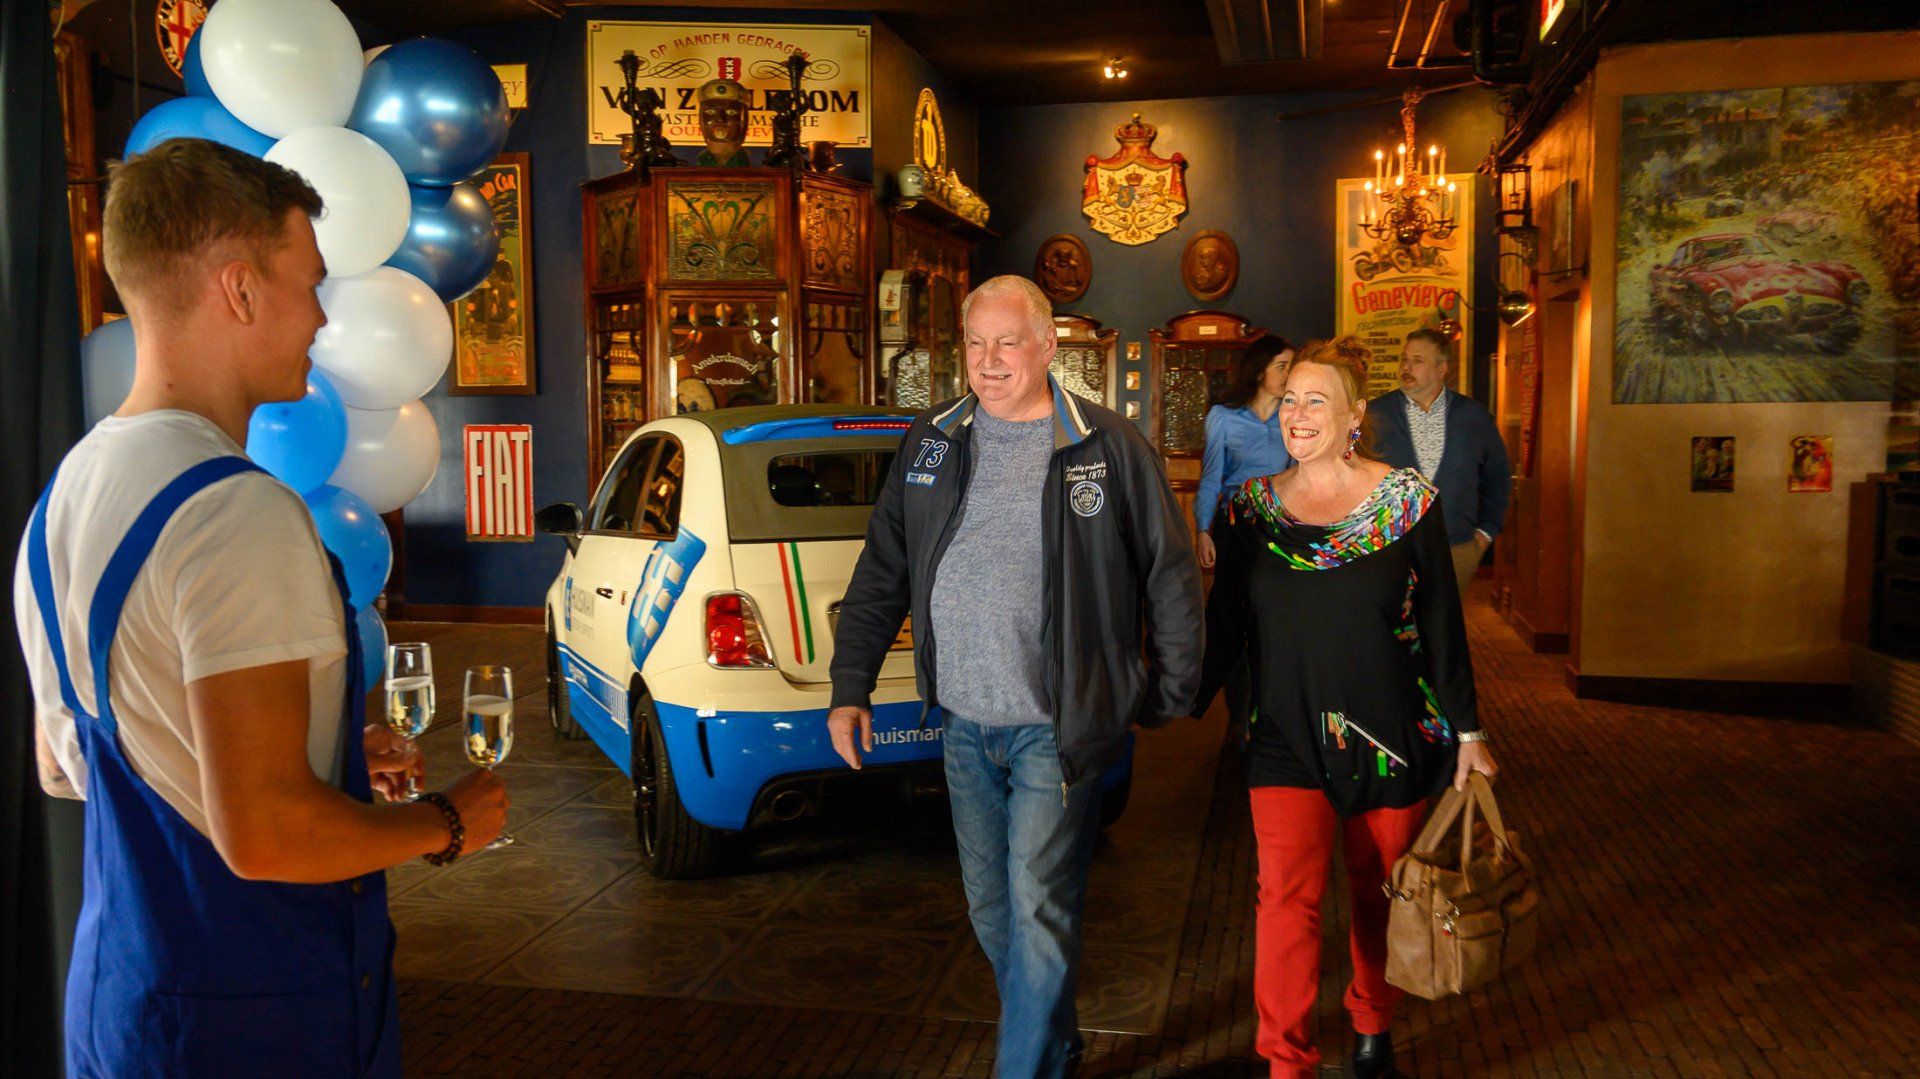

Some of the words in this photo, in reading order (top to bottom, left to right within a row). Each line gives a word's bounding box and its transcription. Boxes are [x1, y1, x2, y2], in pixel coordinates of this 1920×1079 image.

[650, 44, 668, 60] OP
[673, 32, 730, 50] HANDEN
[1351, 281, 1456, 315] Genevieve
[914, 438, 949, 468] 73
[468, 431, 529, 536] FIAT
[1088, 469, 1107, 480] 1873
